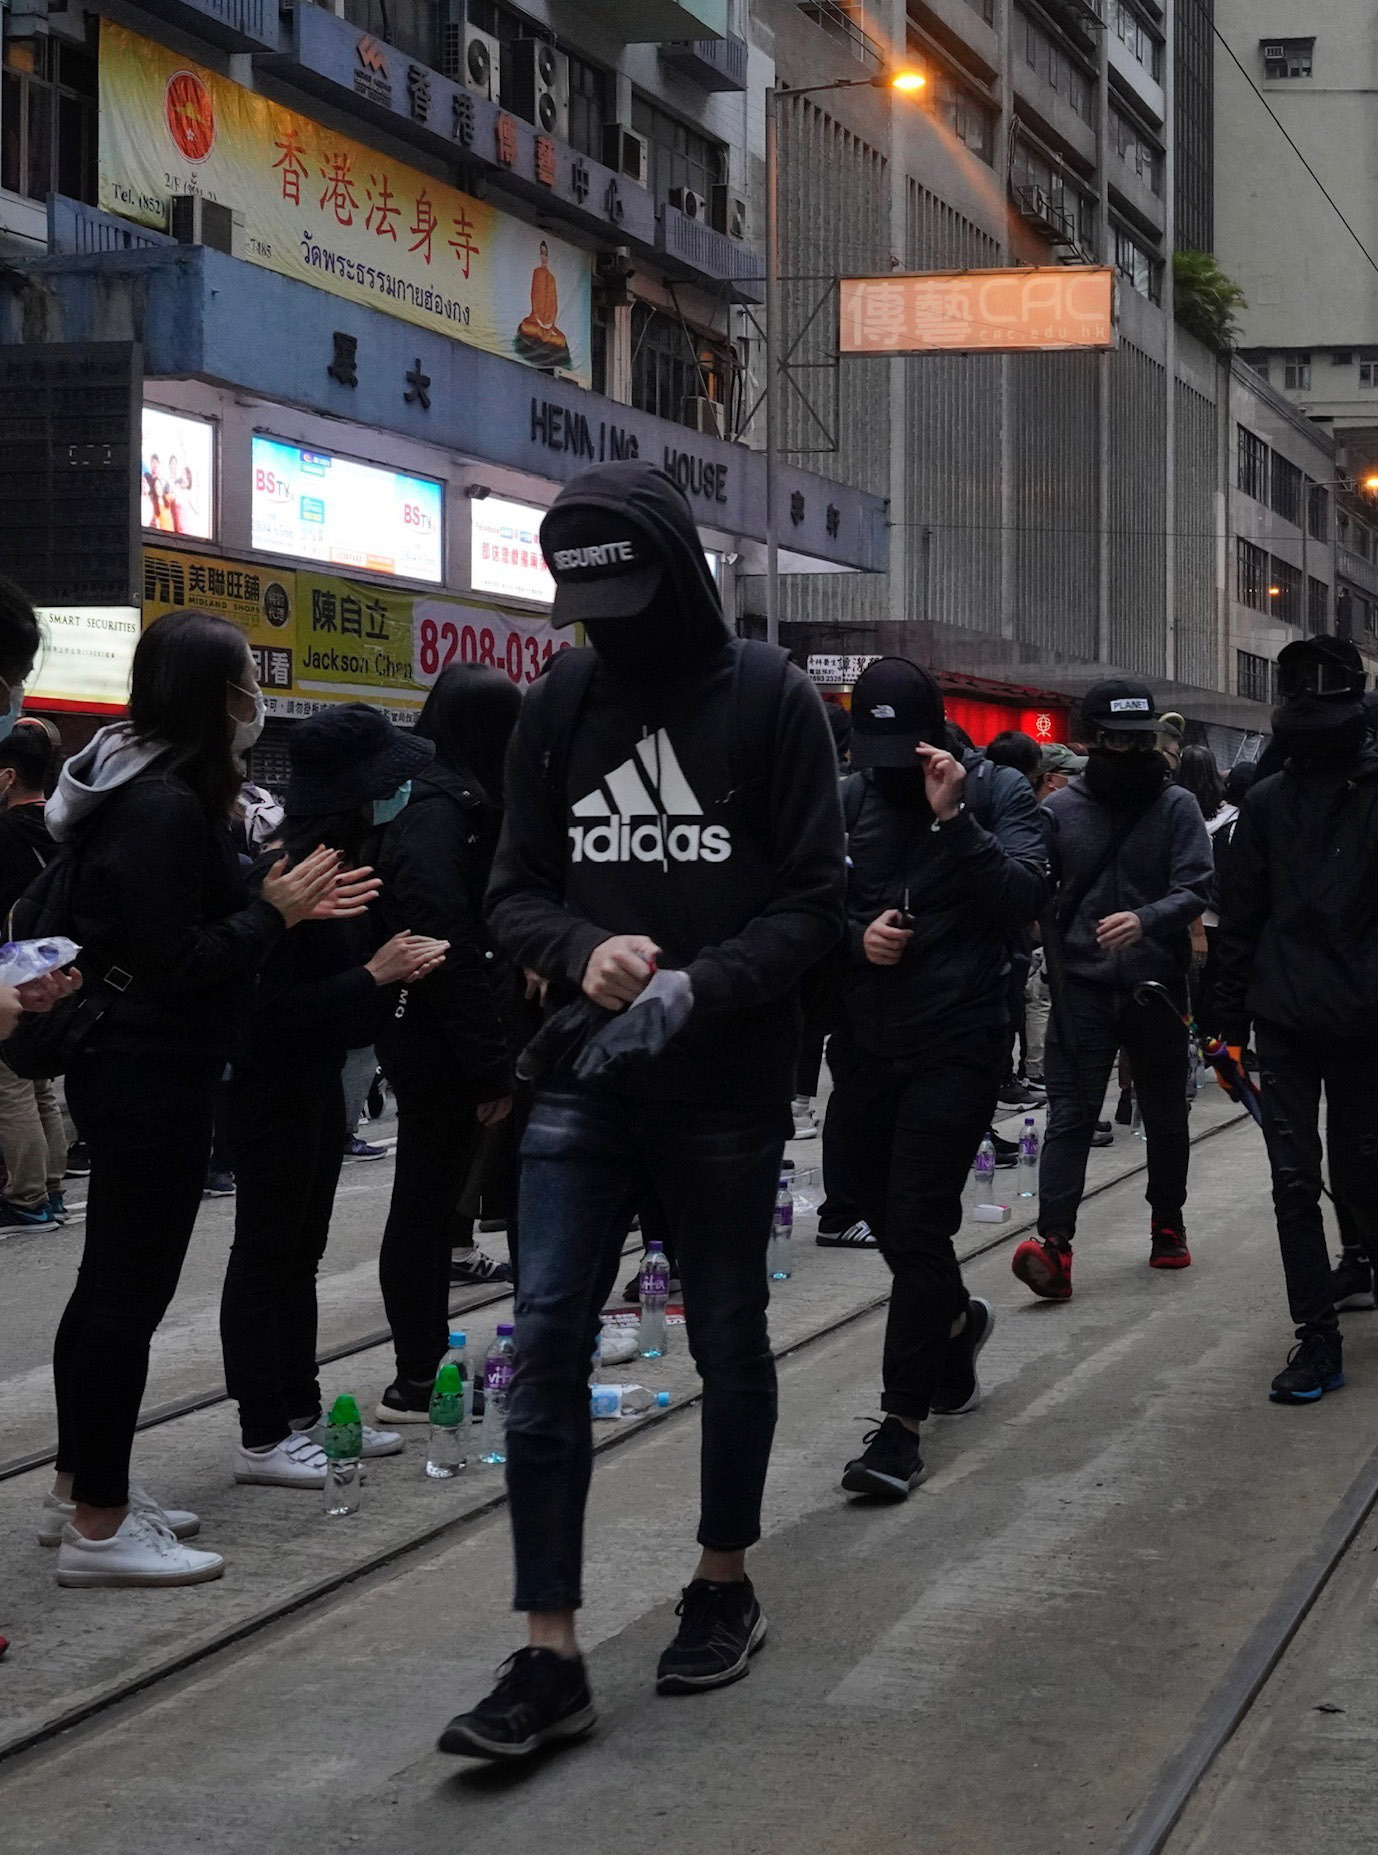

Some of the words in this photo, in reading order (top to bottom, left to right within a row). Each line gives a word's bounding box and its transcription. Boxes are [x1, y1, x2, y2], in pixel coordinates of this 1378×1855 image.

[111, 183, 135, 206] Tel.
[138, 195, 166, 219] (852)
[272, 131, 480, 280] 香港法身寺
[300, 229, 471, 326] วัดพระธรรมกายฮ่องกง
[849, 280, 976, 347] 傳藝
[978, 275, 1106, 323] CAC
[664, 446, 729, 503] HOUSE
[553, 541, 635, 570] SECURITE
[188, 564, 261, 602] 美聯旺舖
[49, 612, 81, 627] SMART
[86, 617, 137, 634] SECURITIES
[189, 596, 228, 610] MIDLAND
[233, 601, 261, 614] SHOPS
[312, 588, 390, 641] 陳自立
[303, 645, 369, 676] Jackson
[1112, 700, 1148, 710] PLANET
